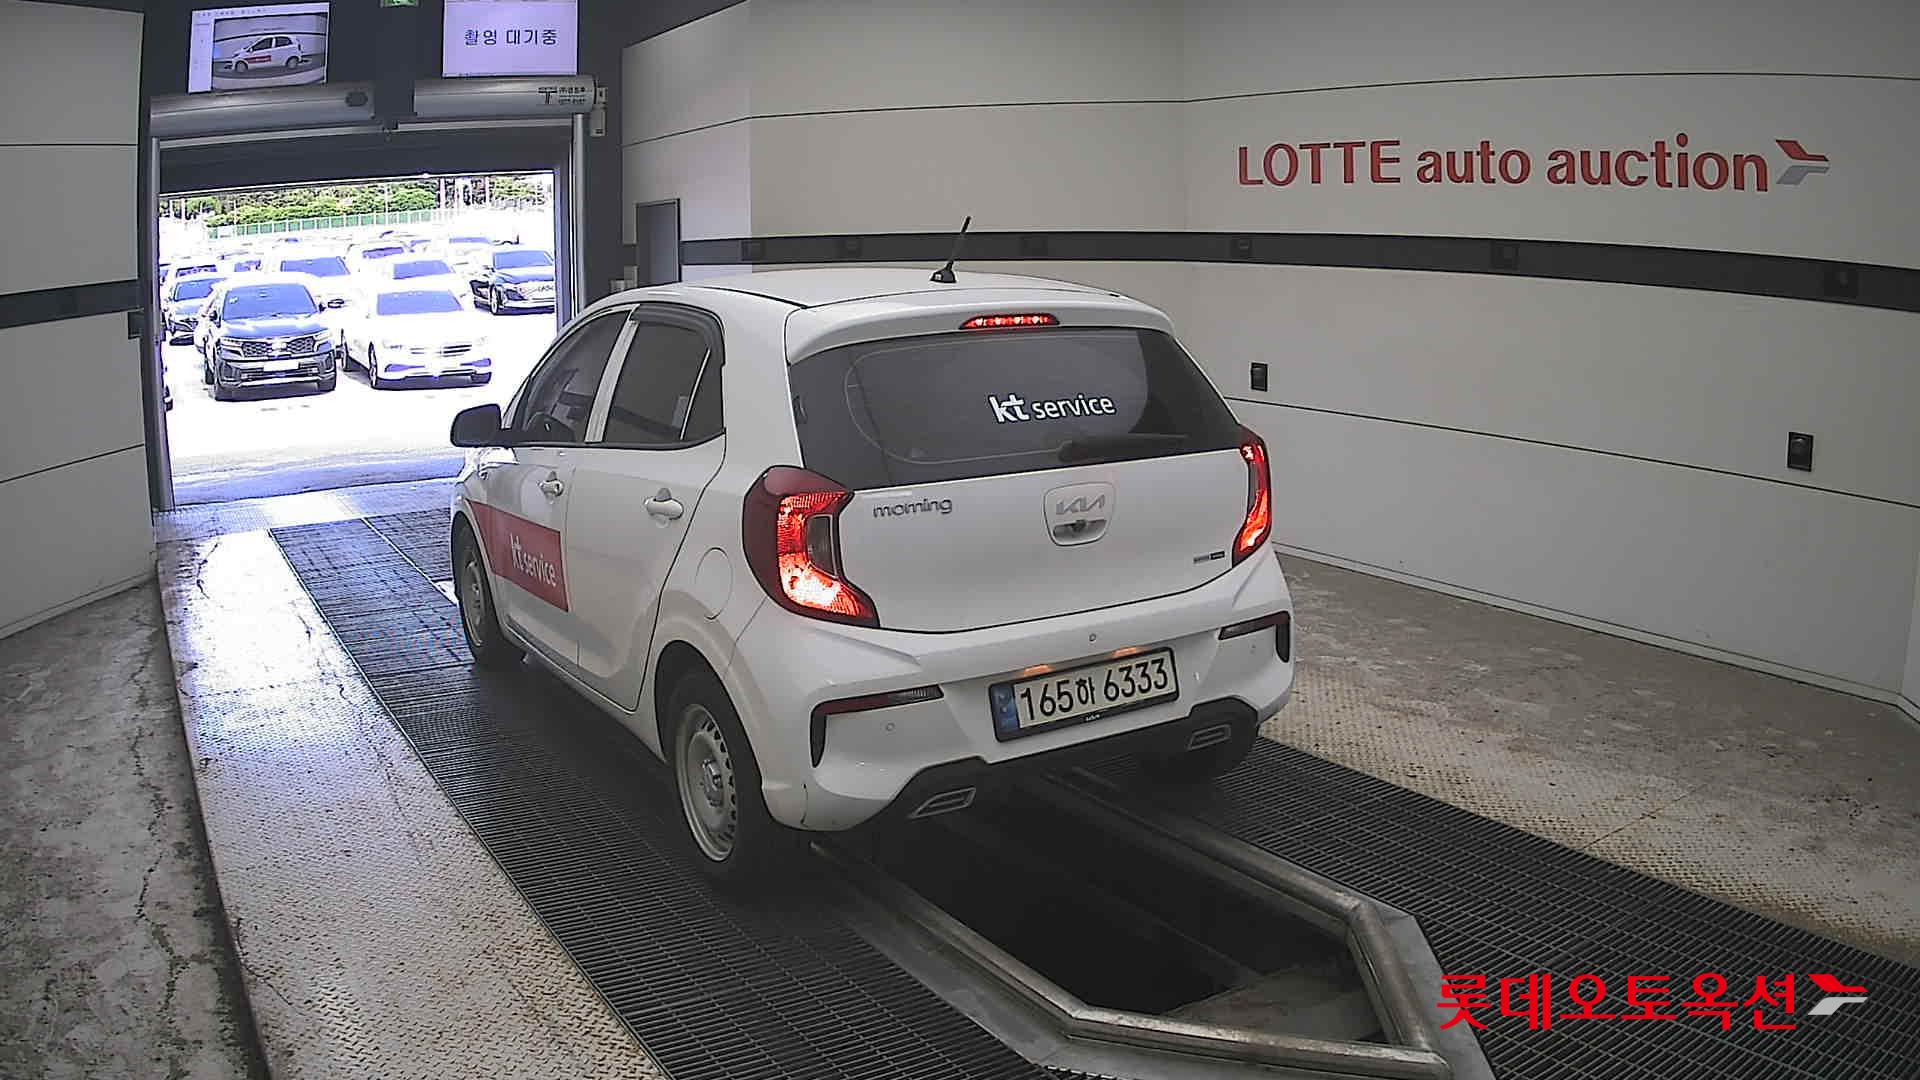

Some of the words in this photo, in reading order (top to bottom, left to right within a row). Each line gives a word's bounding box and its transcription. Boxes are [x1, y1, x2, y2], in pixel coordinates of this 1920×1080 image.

[505, 29, 558, 46] 대기중
[1238, 140, 1401, 186] LOTTE
[1416, 140, 1531, 185] auto
[1546, 133, 1769, 192] auction
[988, 394, 1030, 424] kt
[1034, 396, 1116, 420] service
[510, 532, 524, 571] kt
[522, 552, 556, 587] service
[1020, 676, 1096, 722] 165하
[1103, 657, 1169, 702] 6333
